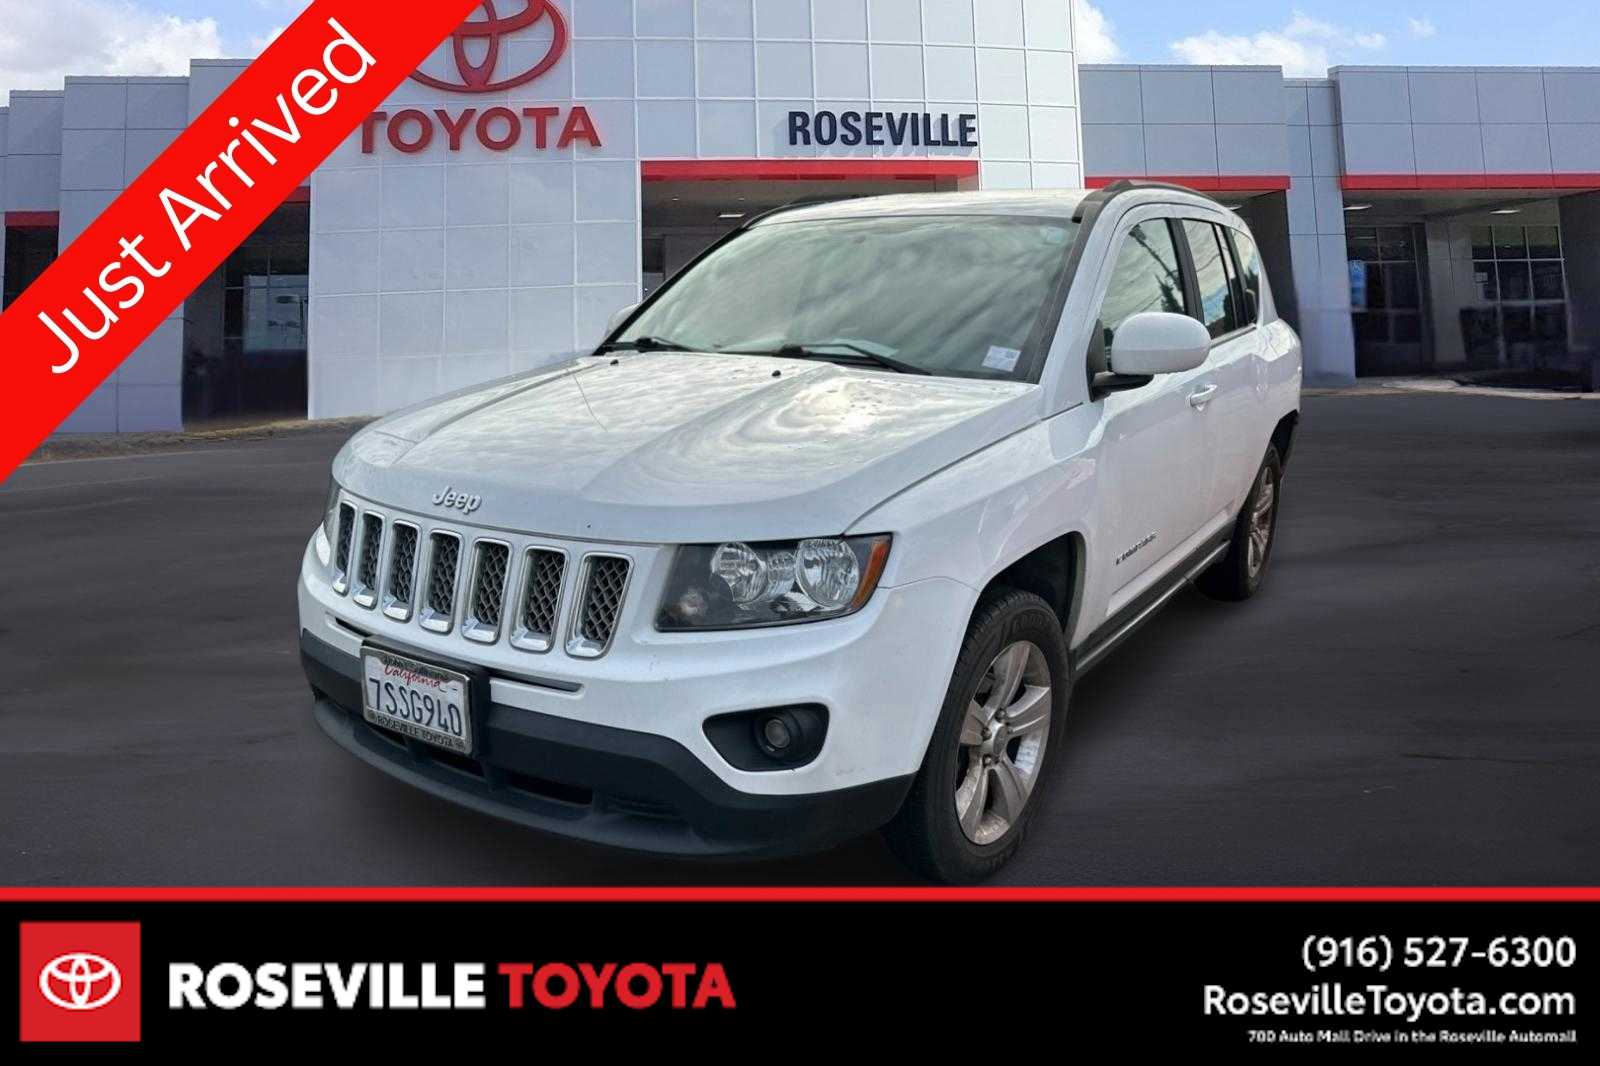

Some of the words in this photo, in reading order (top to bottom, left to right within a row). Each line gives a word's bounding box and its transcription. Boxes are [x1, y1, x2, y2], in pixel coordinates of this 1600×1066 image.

[362, 106, 602, 154] TOYOTA
[788, 110, 978, 147] ROSEVILLE
[432, 486, 482, 514] Jeep
